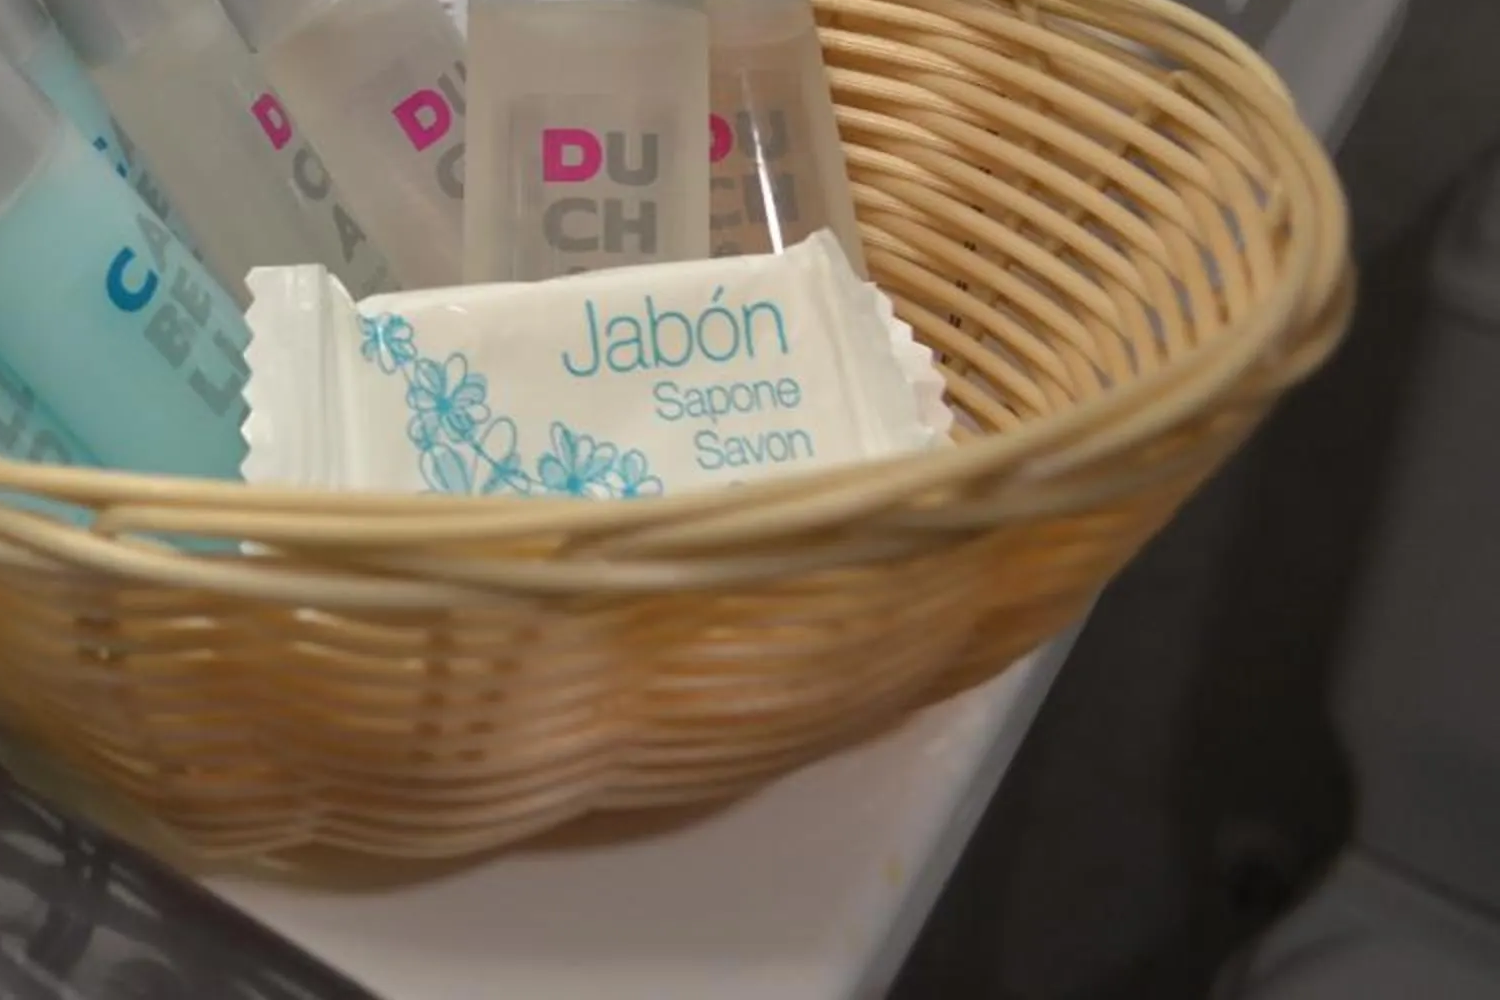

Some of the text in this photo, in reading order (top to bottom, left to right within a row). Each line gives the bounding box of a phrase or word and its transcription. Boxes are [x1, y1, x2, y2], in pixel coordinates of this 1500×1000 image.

[542, 127, 660, 187] DU
[542, 196, 659, 254] CH
[144, 266, 213, 369] BE
[561, 285, 789, 378] Jabón
[653, 377, 802, 424] Sapone
[693, 428, 815, 471] Savon
